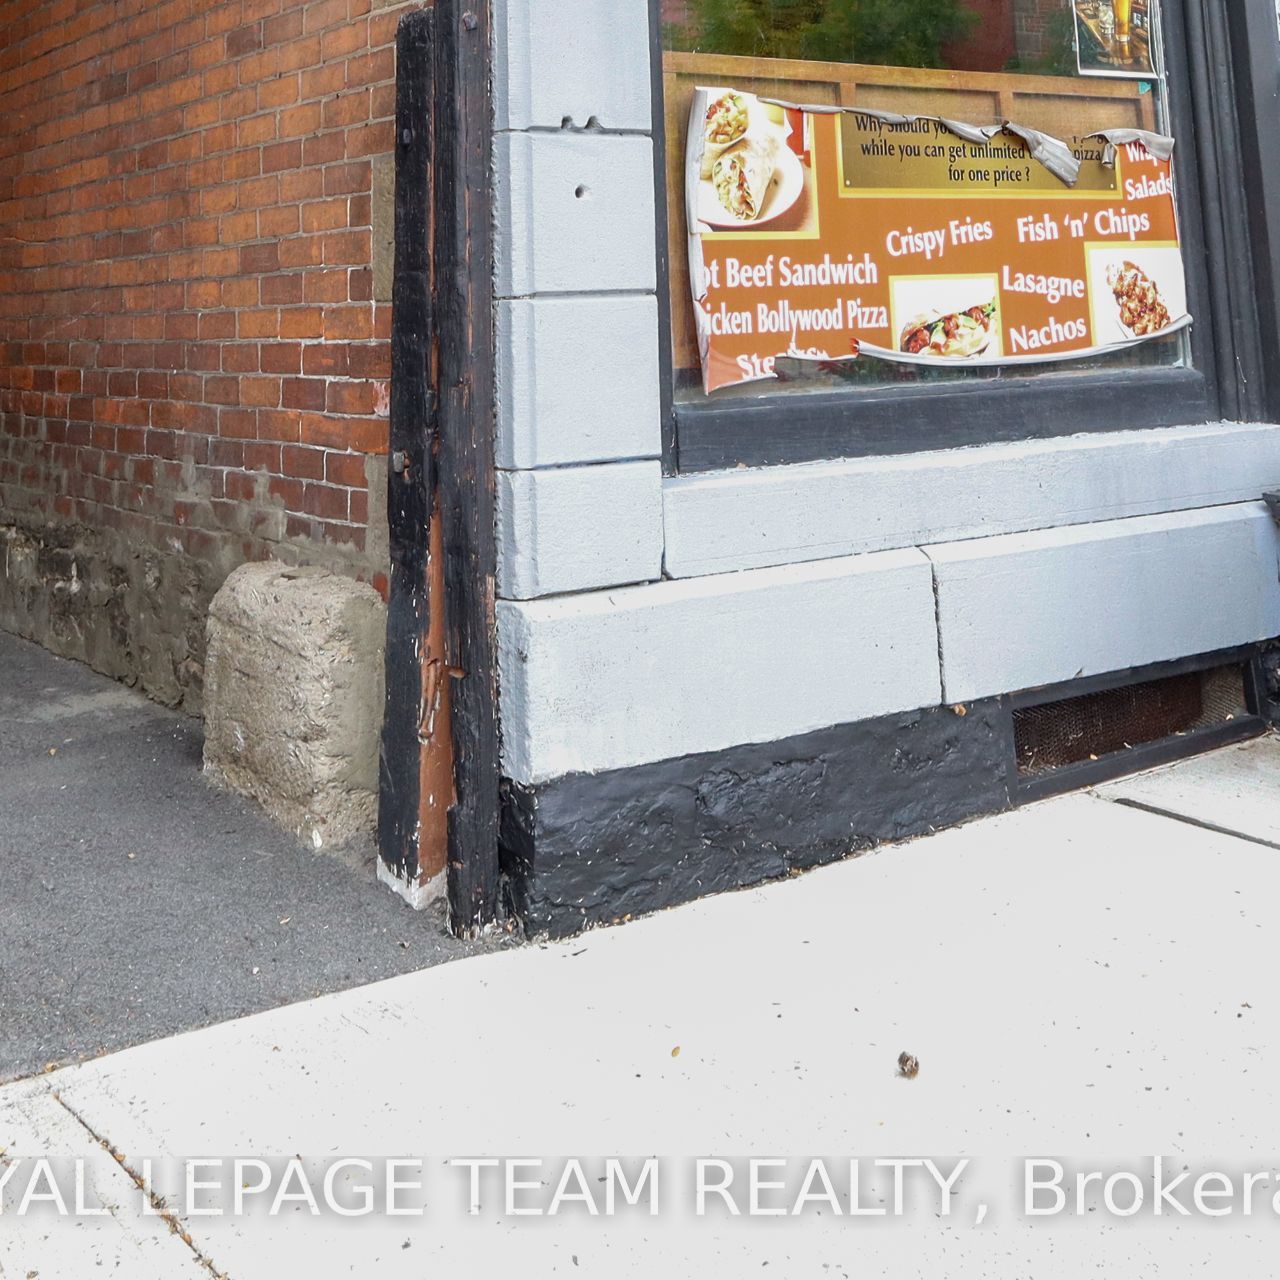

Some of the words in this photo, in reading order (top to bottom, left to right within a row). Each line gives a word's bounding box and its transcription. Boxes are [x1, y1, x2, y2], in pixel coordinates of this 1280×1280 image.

[861, 139, 895, 156] while
[898, 143, 920, 162] you
[924, 144, 945, 158] can
[948, 143, 967, 163] get
[970, 140, 1025, 160] unlimited
[948, 164, 965, 181] for
[968, 168, 990, 182] one
[993, 166, 1022, 187] price
[886, 227, 946, 260] Crispy
[949, 217, 993, 246] Fries
[1017, 213, 1059, 243] Fish
[1094, 207, 1151, 241] Chips
[725, 254, 774, 288] Beef
[778, 252, 878, 287] Sandwich
[1002, 265, 1085, 303] Lasagne
[756, 297, 843, 336] Bollywood
[847, 297, 889, 329] Pizza
[1009, 316, 1087, 353] Nachos
